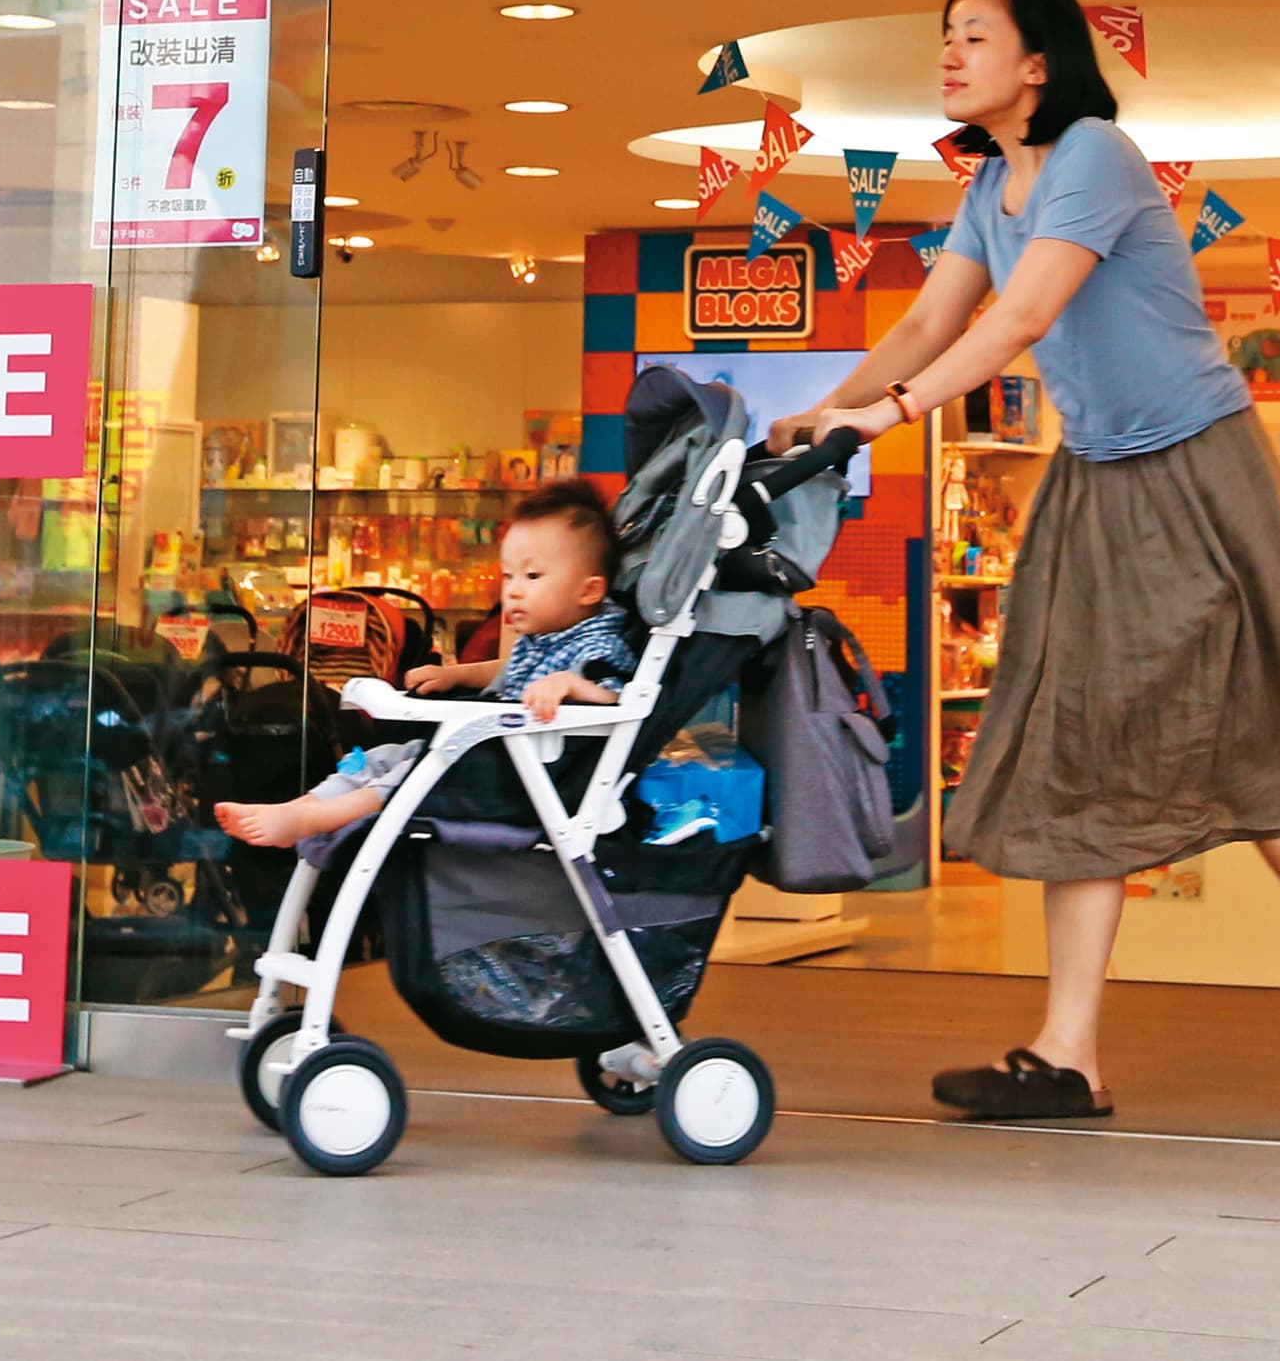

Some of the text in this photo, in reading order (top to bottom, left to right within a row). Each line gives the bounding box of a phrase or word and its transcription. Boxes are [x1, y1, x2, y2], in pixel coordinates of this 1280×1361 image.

[129, 36, 236, 66] 改裝出清
[151, 82, 229, 190] 7
[217, 170, 233, 187] 折
[848, 166, 888, 194] SALE
[753, 206, 790, 239] SALE
[1200, 205, 1231, 238] SALE
[696, 255, 801, 291] MEGA
[920, 246, 945, 268] SAL
[695, 291, 800, 327] BLOKS
